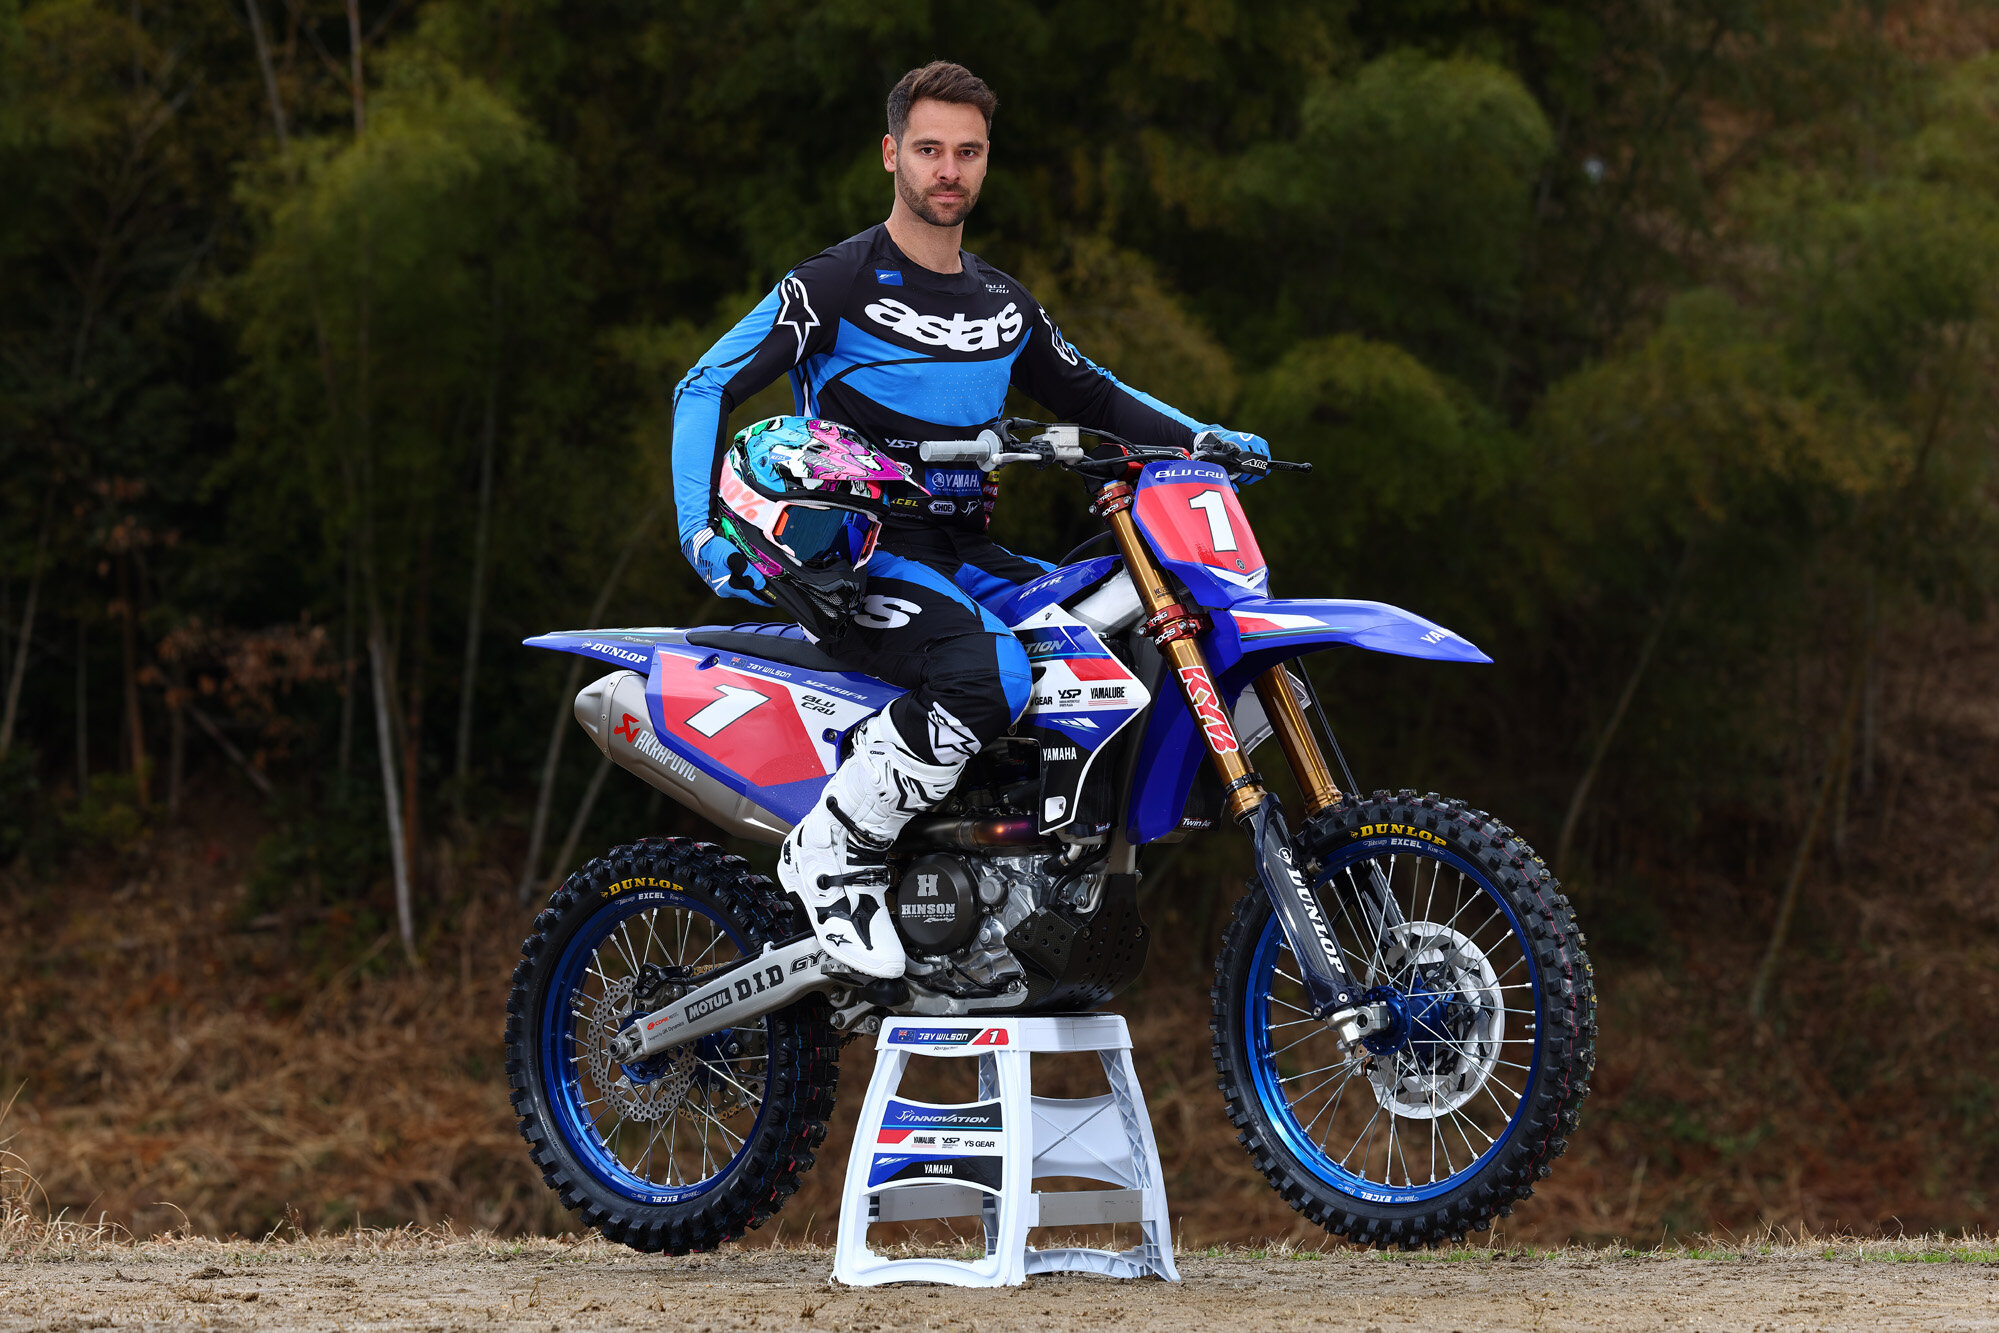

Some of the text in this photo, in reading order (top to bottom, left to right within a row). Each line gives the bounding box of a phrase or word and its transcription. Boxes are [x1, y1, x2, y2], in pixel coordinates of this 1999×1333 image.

[885, 438, 918, 448] YSP
[1241, 459, 1267, 469] ARC
[1155, 469, 1224, 479] BLU CRU
[1188, 489, 1238, 552] 1
[591, 643, 648, 664] DUNLOP
[1025, 640, 1067, 654] TION
[1058, 689, 1081, 699] YSP
[1090, 687, 1125, 699] YAMALUBE
[802, 695, 835, 708] BLU
[1035, 696, 1053, 706] GEAR
[684, 684, 772, 739] 1
[801, 702, 836, 716] CRU
[1178, 665, 1239, 754] KYB
[1043, 747, 1077, 761] YAMAHA
[1360, 823, 1447, 847] DUNLOP
[1391, 838, 1422, 848] EXCEL
[609, 877, 683, 896] DUNLOP
[917, 874, 938, 896] H
[638, 892, 665, 900] EXCEL
[901, 903, 956, 915] HINSON
[1286, 867, 1346, 974] DUNLOP
[734, 965, 784, 1001] D.I.D
[688, 991, 730, 1021] MOTUL
[988, 1030, 999, 1044] 1
[909, 1114, 990, 1124] INNOVATION
[924, 1164, 953, 1175] YAMAHA
[652, 1194, 679, 1203] EXCEL
[1361, 1191, 1392, 1202] EXCEL
